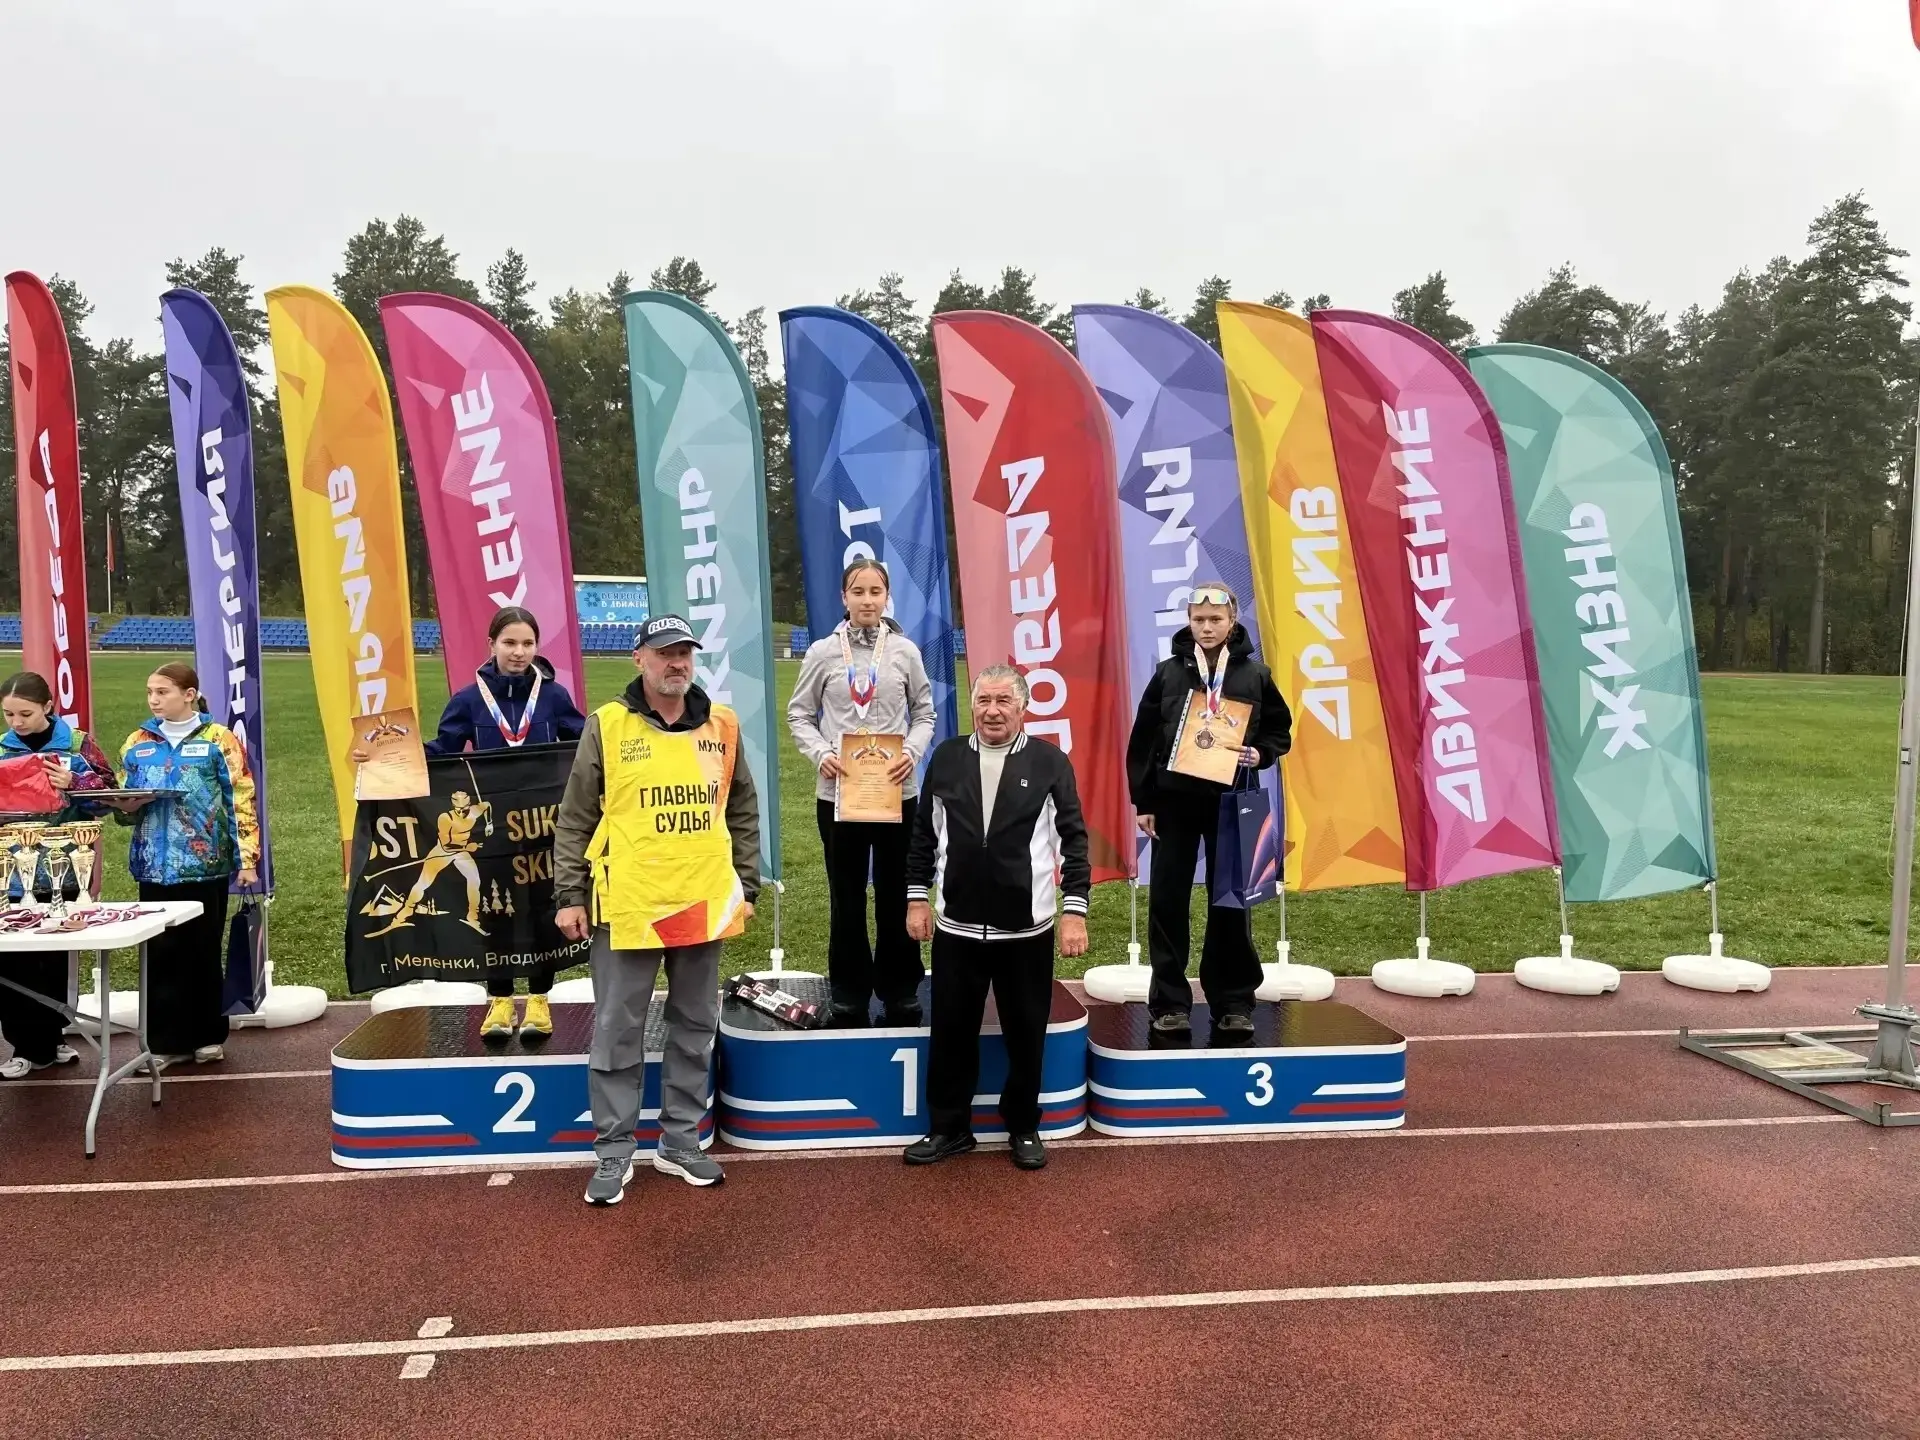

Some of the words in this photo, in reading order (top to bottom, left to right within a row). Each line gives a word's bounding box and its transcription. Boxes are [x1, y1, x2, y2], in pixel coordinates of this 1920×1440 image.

[1290, 486, 1352, 740] ДРАЙВ
[1382, 400, 1487, 822] ДВИЖЕНИЕ
[1561, 502, 1651, 759] ЖИЗНЬ
[620, 738, 644, 747] СПОРТ
[620, 745, 651, 755] НОРМА
[620, 752, 652, 763] ЖИЗНИ
[640, 780, 719, 809] ГЛАВНЫЙ
[369, 816, 418, 860] ST
[506, 803, 561, 842] SUK
[655, 810, 711, 834] СУДЬЯ
[380, 963, 391, 974] г.
[394, 953, 480, 970] Меленки,
[485, 935, 594, 967] Владимирск
[492, 1071, 536, 1133] 2
[890, 1048, 917, 1116] 1
[1245, 1062, 1274, 1107] 3
